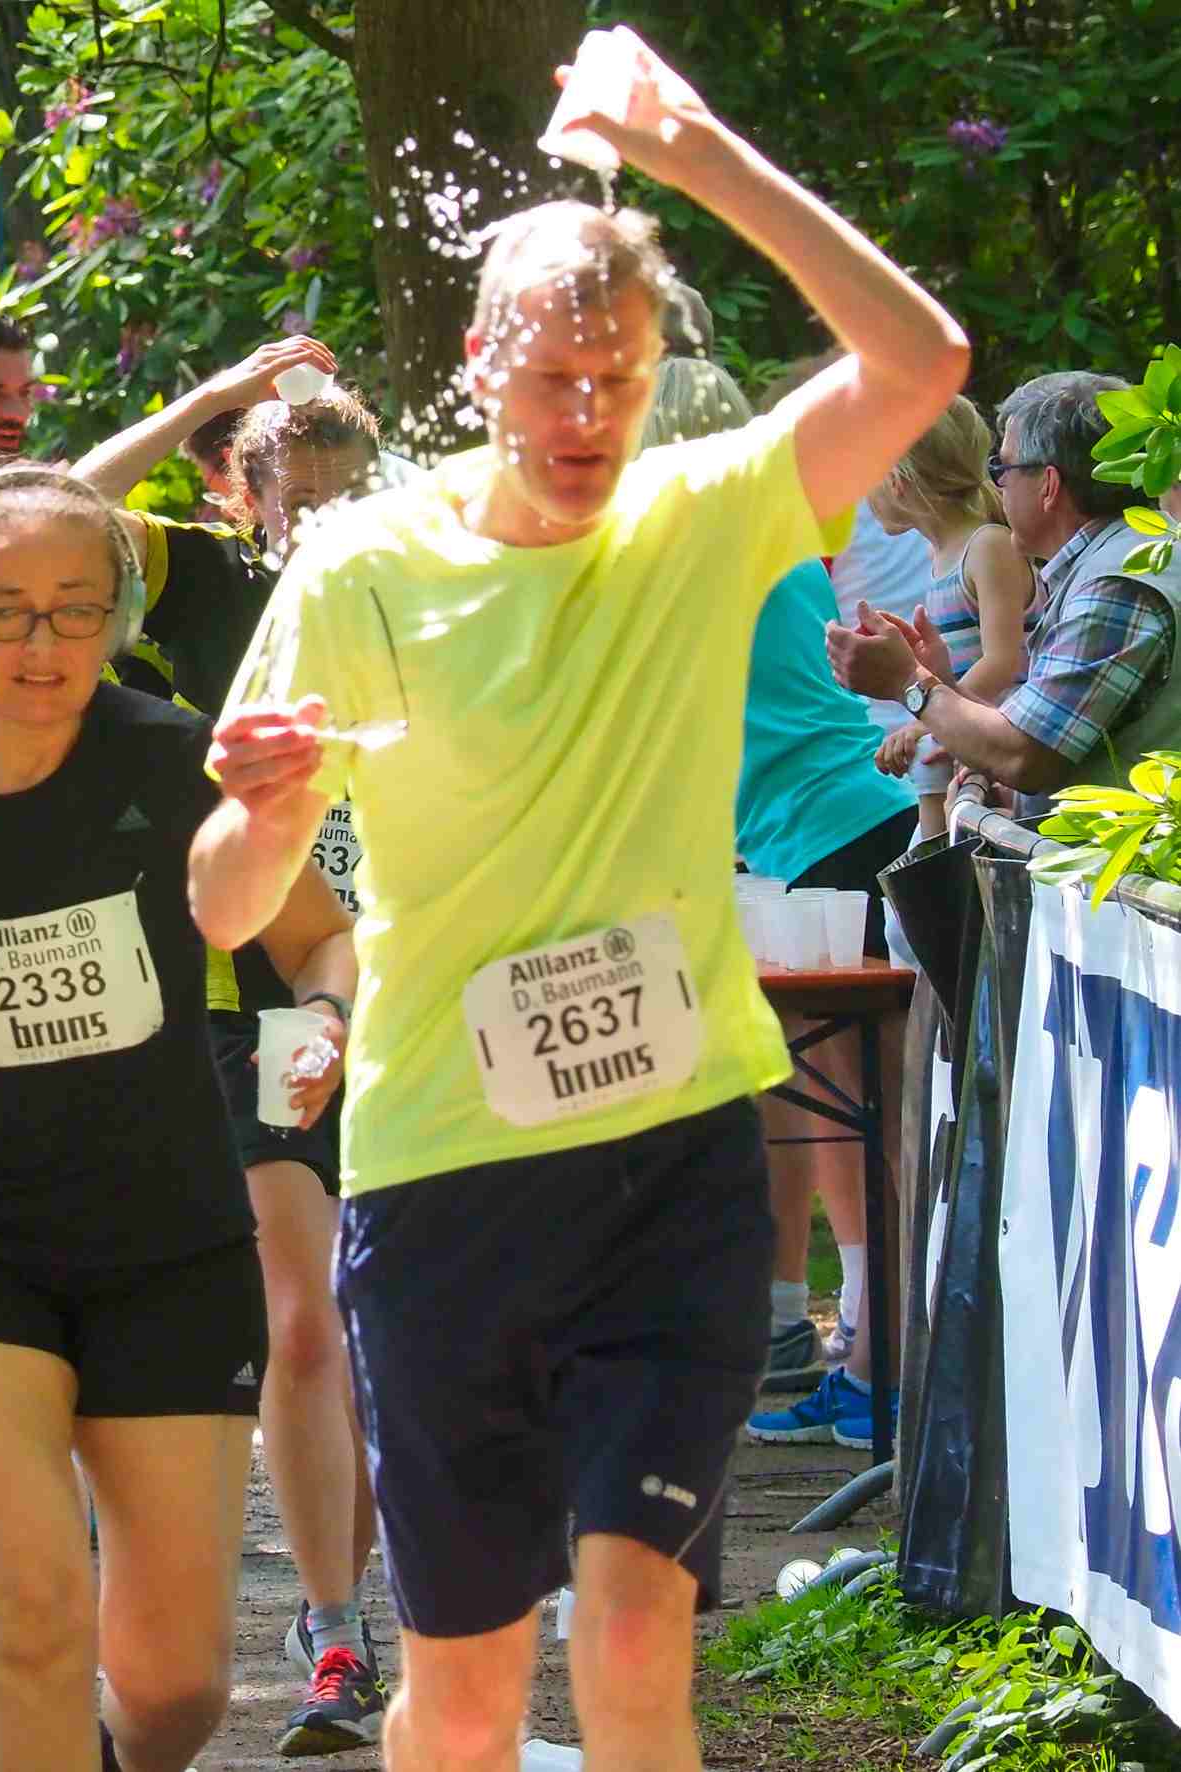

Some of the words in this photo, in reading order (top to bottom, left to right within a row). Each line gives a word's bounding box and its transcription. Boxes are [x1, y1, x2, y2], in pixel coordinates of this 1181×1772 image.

[7, 937, 103, 970] Baumann
[509, 946, 601, 987] Allianz
[511, 988, 539, 1012] D.
[540, 960, 644, 1004] Baumann
[9, 1010, 109, 1049] bruns
[526, 985, 643, 1057] 2637
[547, 1042, 656, 1099] bruns
